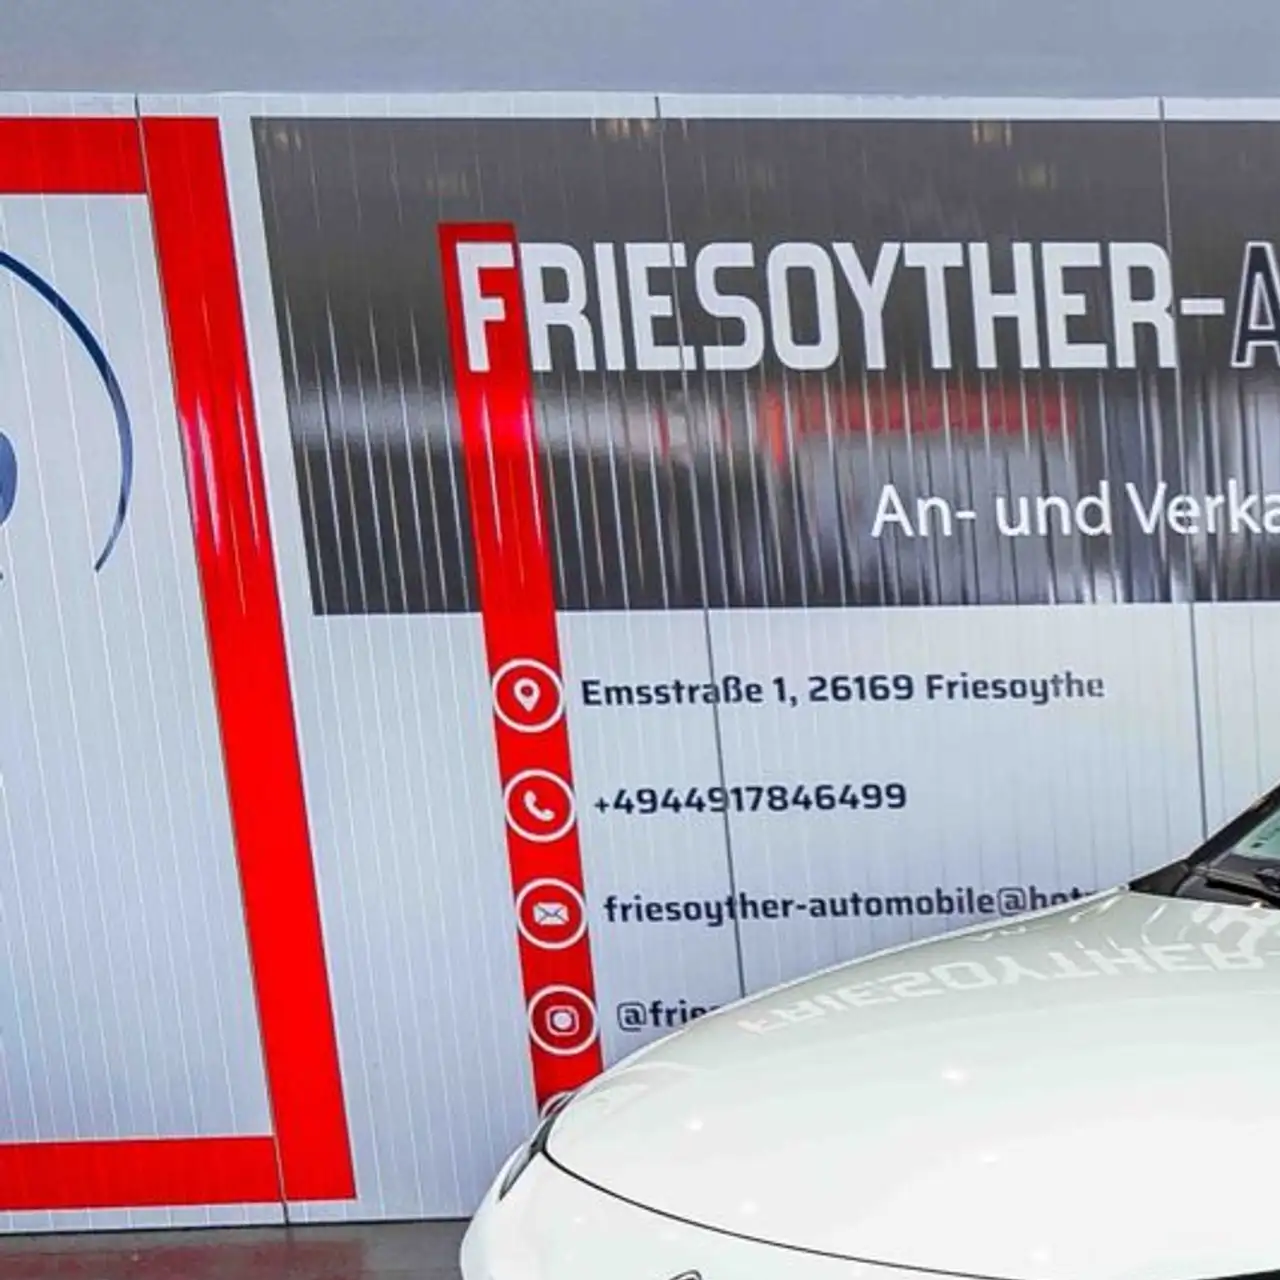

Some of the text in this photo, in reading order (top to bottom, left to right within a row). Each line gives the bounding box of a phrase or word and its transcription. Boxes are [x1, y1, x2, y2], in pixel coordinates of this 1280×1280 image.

[870, 484, 975, 538] An-
[996, 480, 1112, 537] und
[582, 670, 1105, 708] Emsstraße 1, 26169 Friesoythe
[593, 782, 908, 815] +4944917846499
